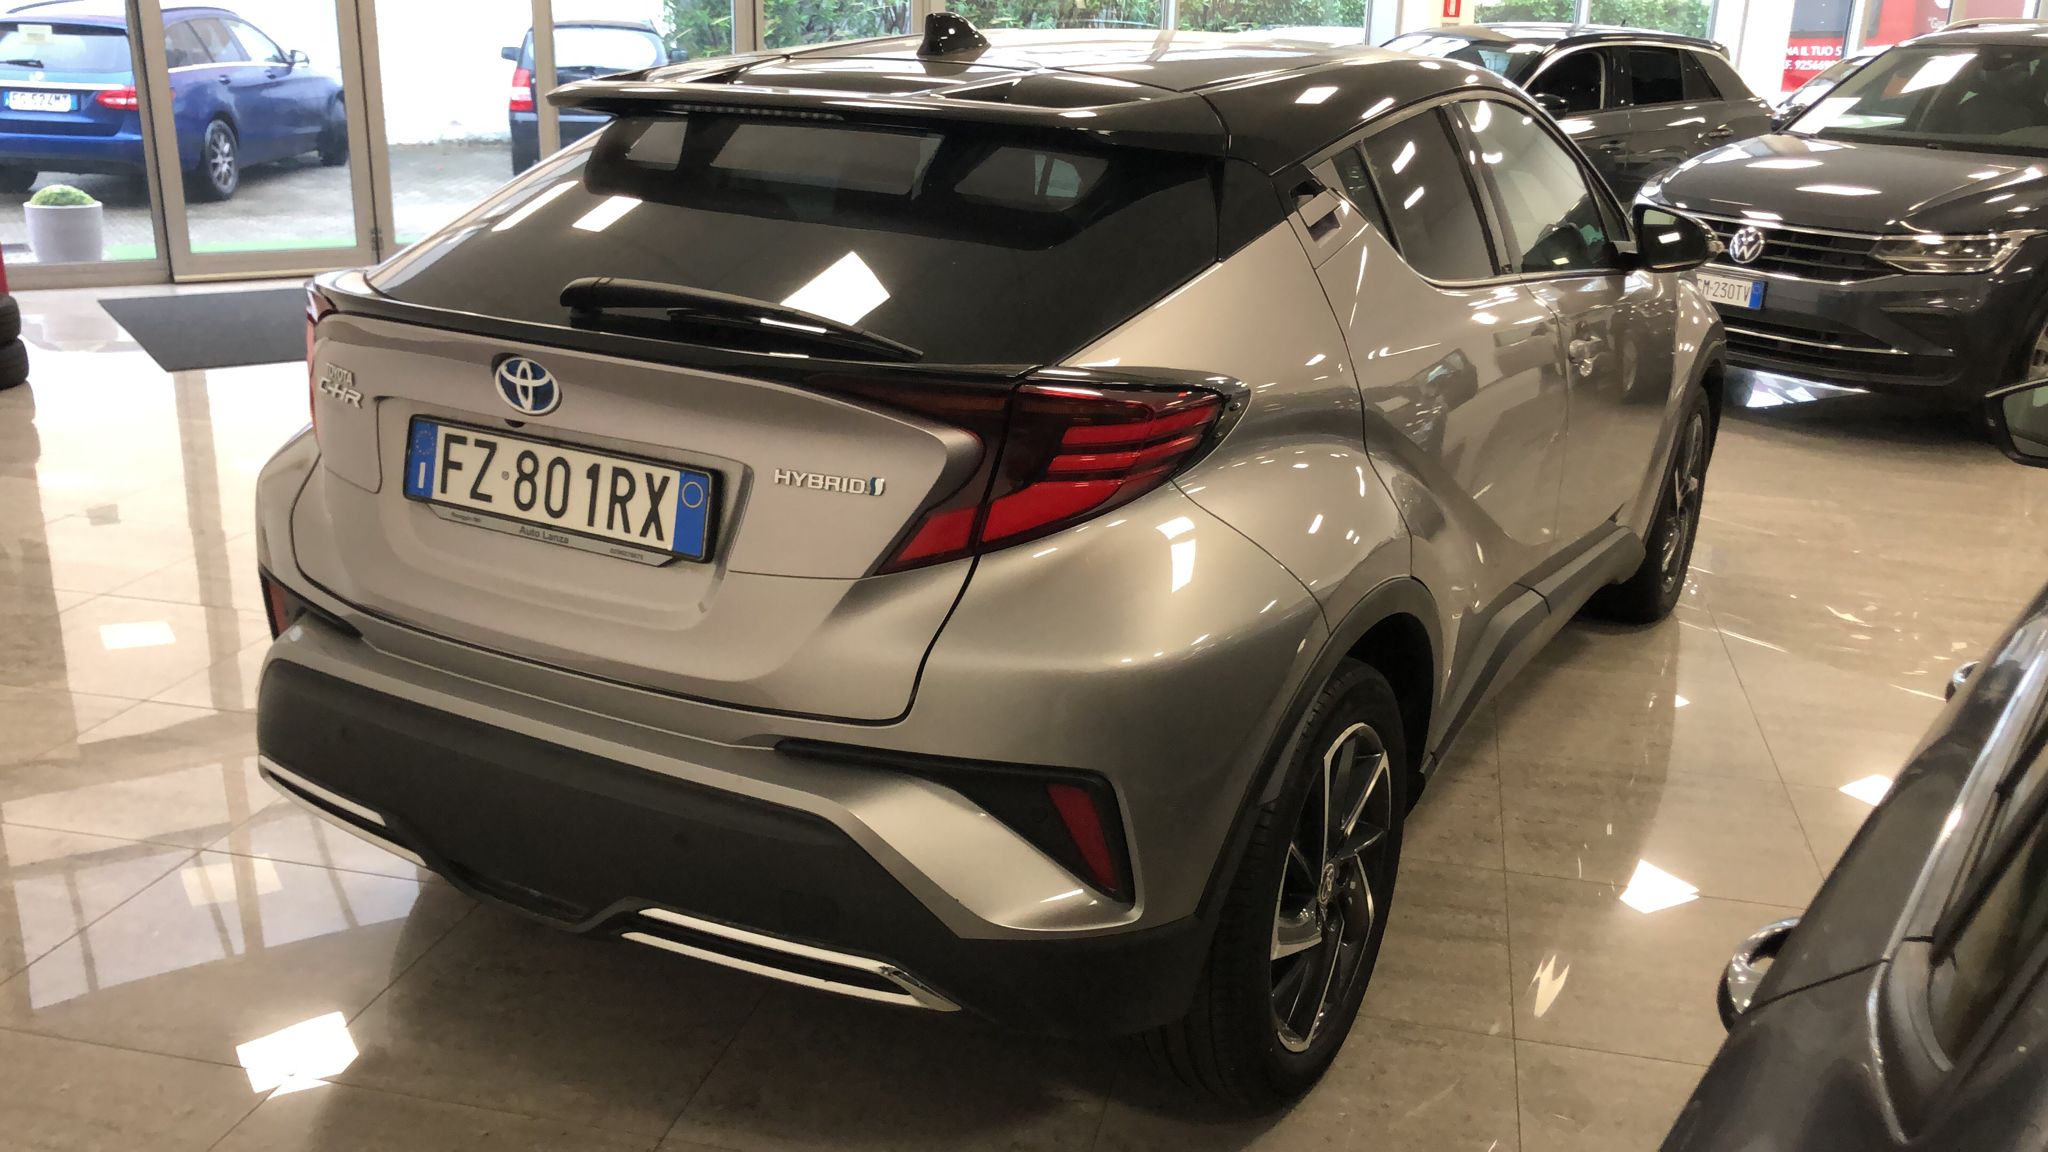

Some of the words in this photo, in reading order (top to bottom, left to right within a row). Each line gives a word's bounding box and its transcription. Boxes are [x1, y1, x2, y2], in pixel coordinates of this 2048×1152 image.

[1811, 45, 1834, 56] TUO
[774, 468, 867, 495] HYBRID
[519, 525, 541, 538] Auto
[542, 530, 570, 545] Lanza
